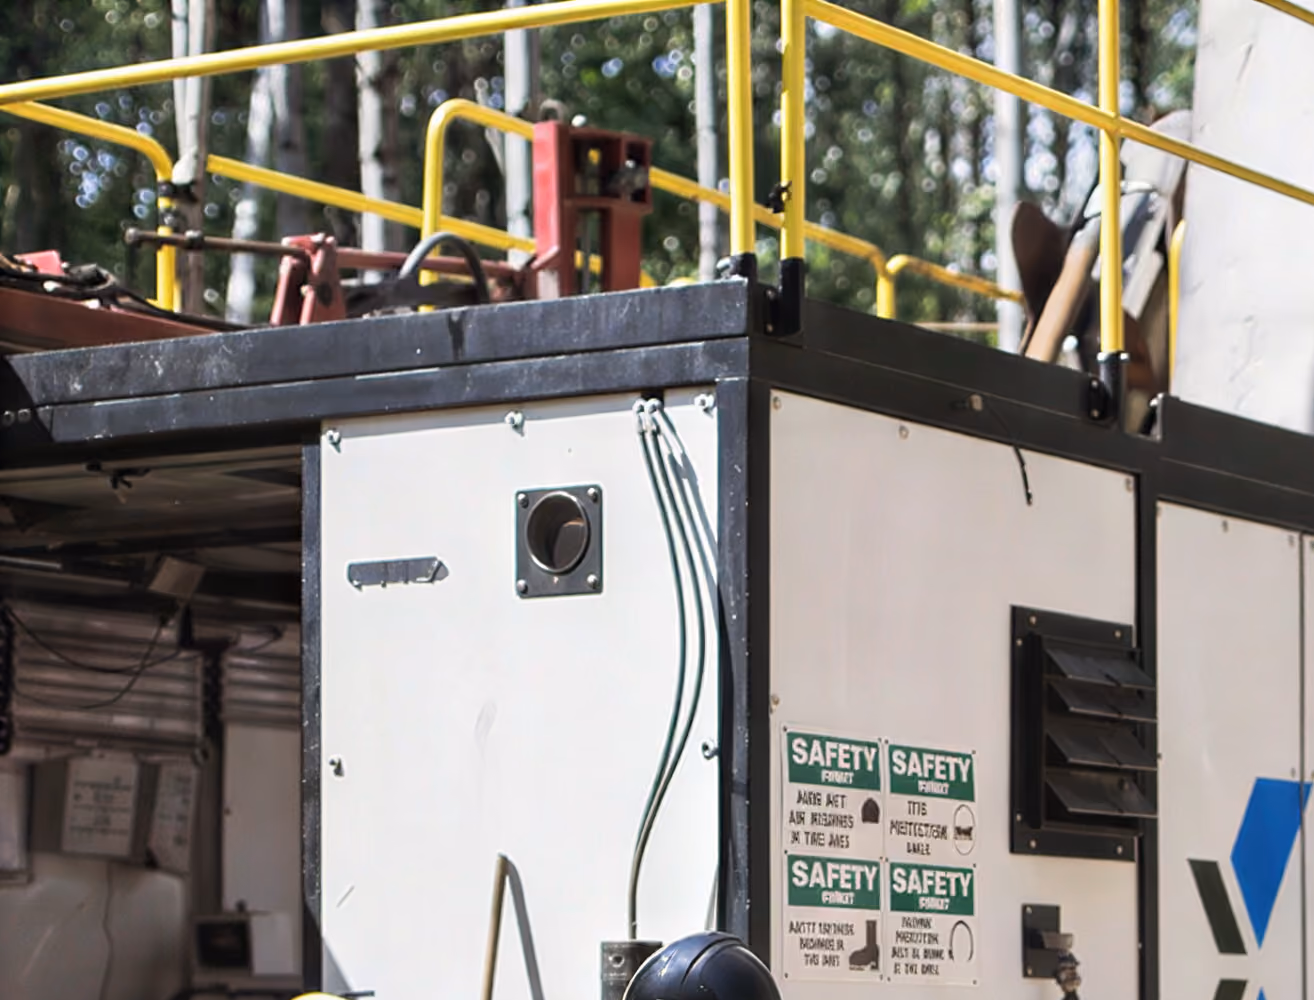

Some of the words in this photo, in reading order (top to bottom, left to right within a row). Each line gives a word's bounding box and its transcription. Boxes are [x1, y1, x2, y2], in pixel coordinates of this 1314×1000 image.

[792, 737, 877, 772] SAFETY
[892, 749, 971, 783] SAFETY
[792, 860, 878, 892] SAFETY
[893, 867, 972, 898] SAFETY
